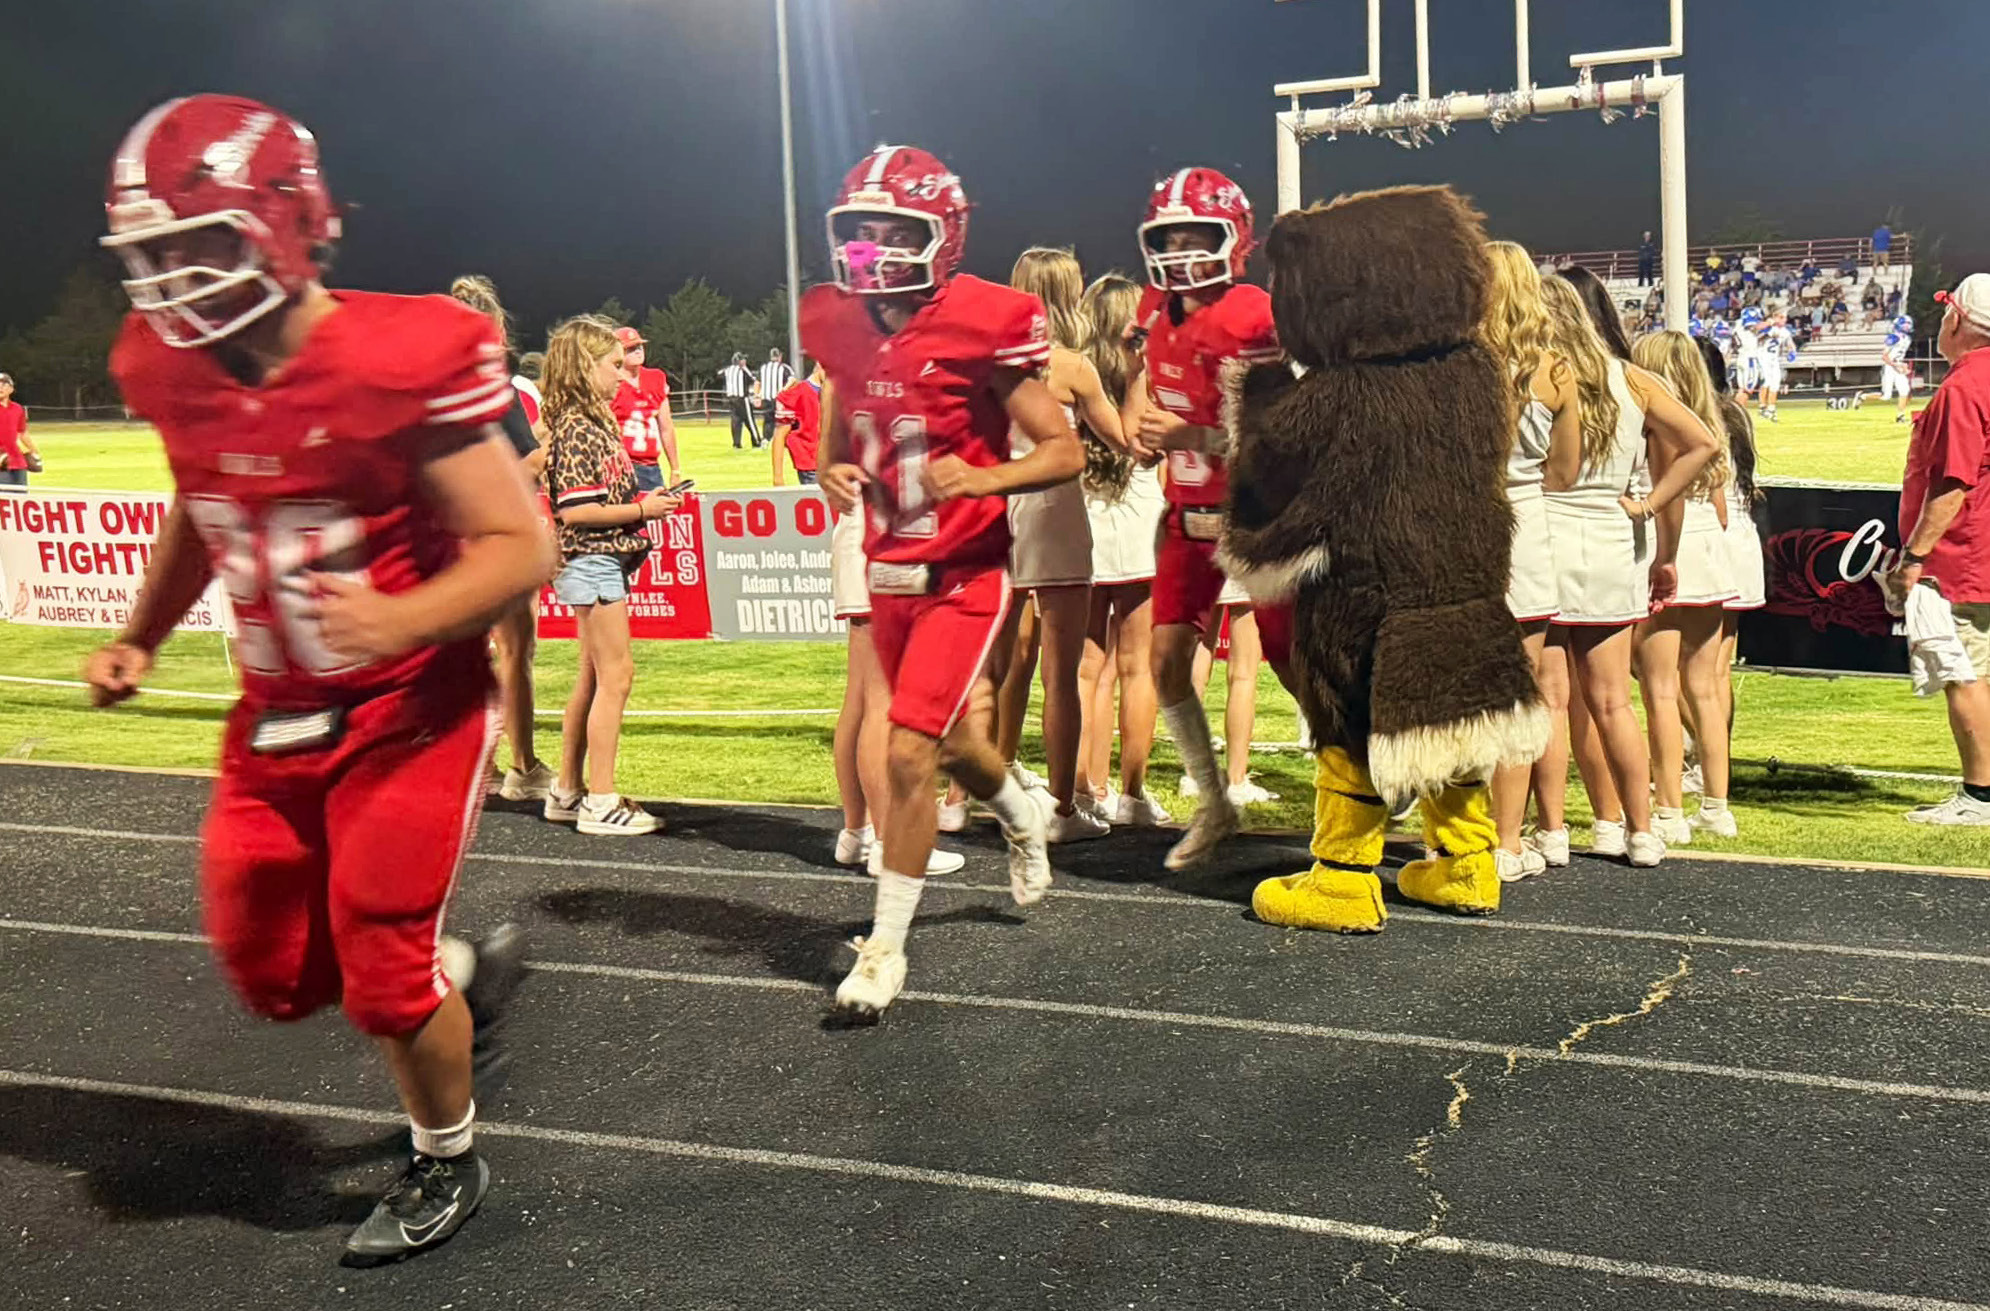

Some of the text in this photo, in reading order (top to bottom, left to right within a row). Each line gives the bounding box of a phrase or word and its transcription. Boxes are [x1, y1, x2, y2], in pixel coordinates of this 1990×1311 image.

[0, 499, 87, 534] FIGHT
[713, 497, 840, 537] GO O
[38, 541, 157, 575] FIGHT!
[716, 549, 833, 570] Aaron, Jolee, Andr
[33, 584, 74, 603] MATT,
[741, 574, 780, 594] Adam
[781, 577, 792, 593] &
[38, 605, 95, 622] AUBREY
[101, 609, 111, 623] &
